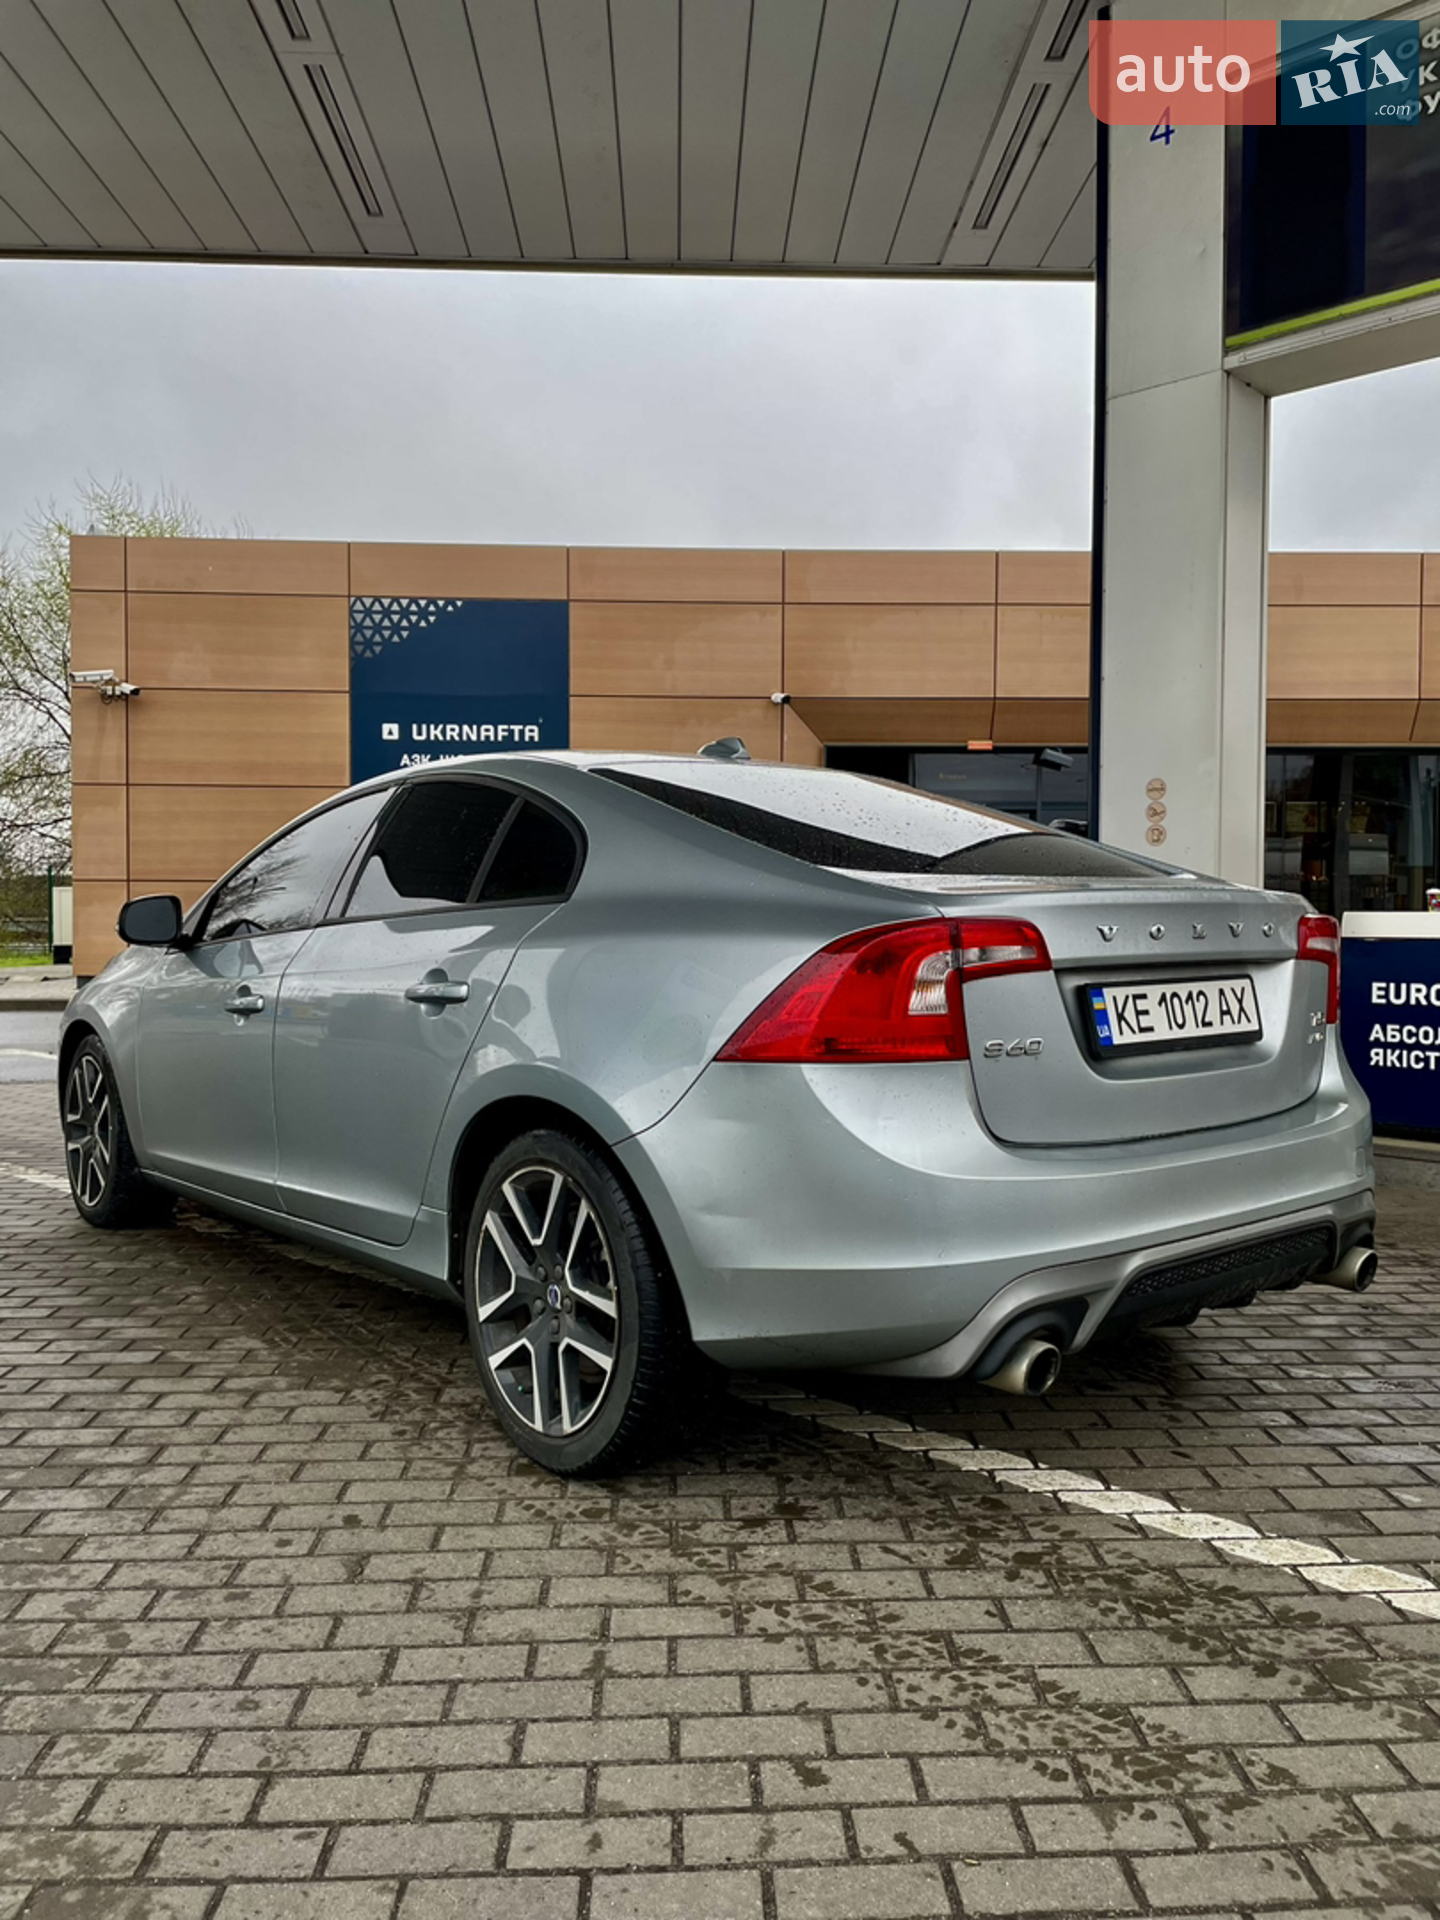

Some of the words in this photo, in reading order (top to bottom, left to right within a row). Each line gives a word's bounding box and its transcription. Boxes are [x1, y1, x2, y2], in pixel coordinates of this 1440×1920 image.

[1149, 106, 1175, 146] 4
[412, 723, 539, 742] UKRNAFTA
[1097, 922, 1275, 942] VOLVO
[1112, 993, 1154, 1036] KE
[1158, 989, 1213, 1031] 1012
[1219, 986, 1252, 1026] AX
[983, 1038, 1044, 1058] S60
[1369, 1048, 1440, 1070] ЯКІСТ
